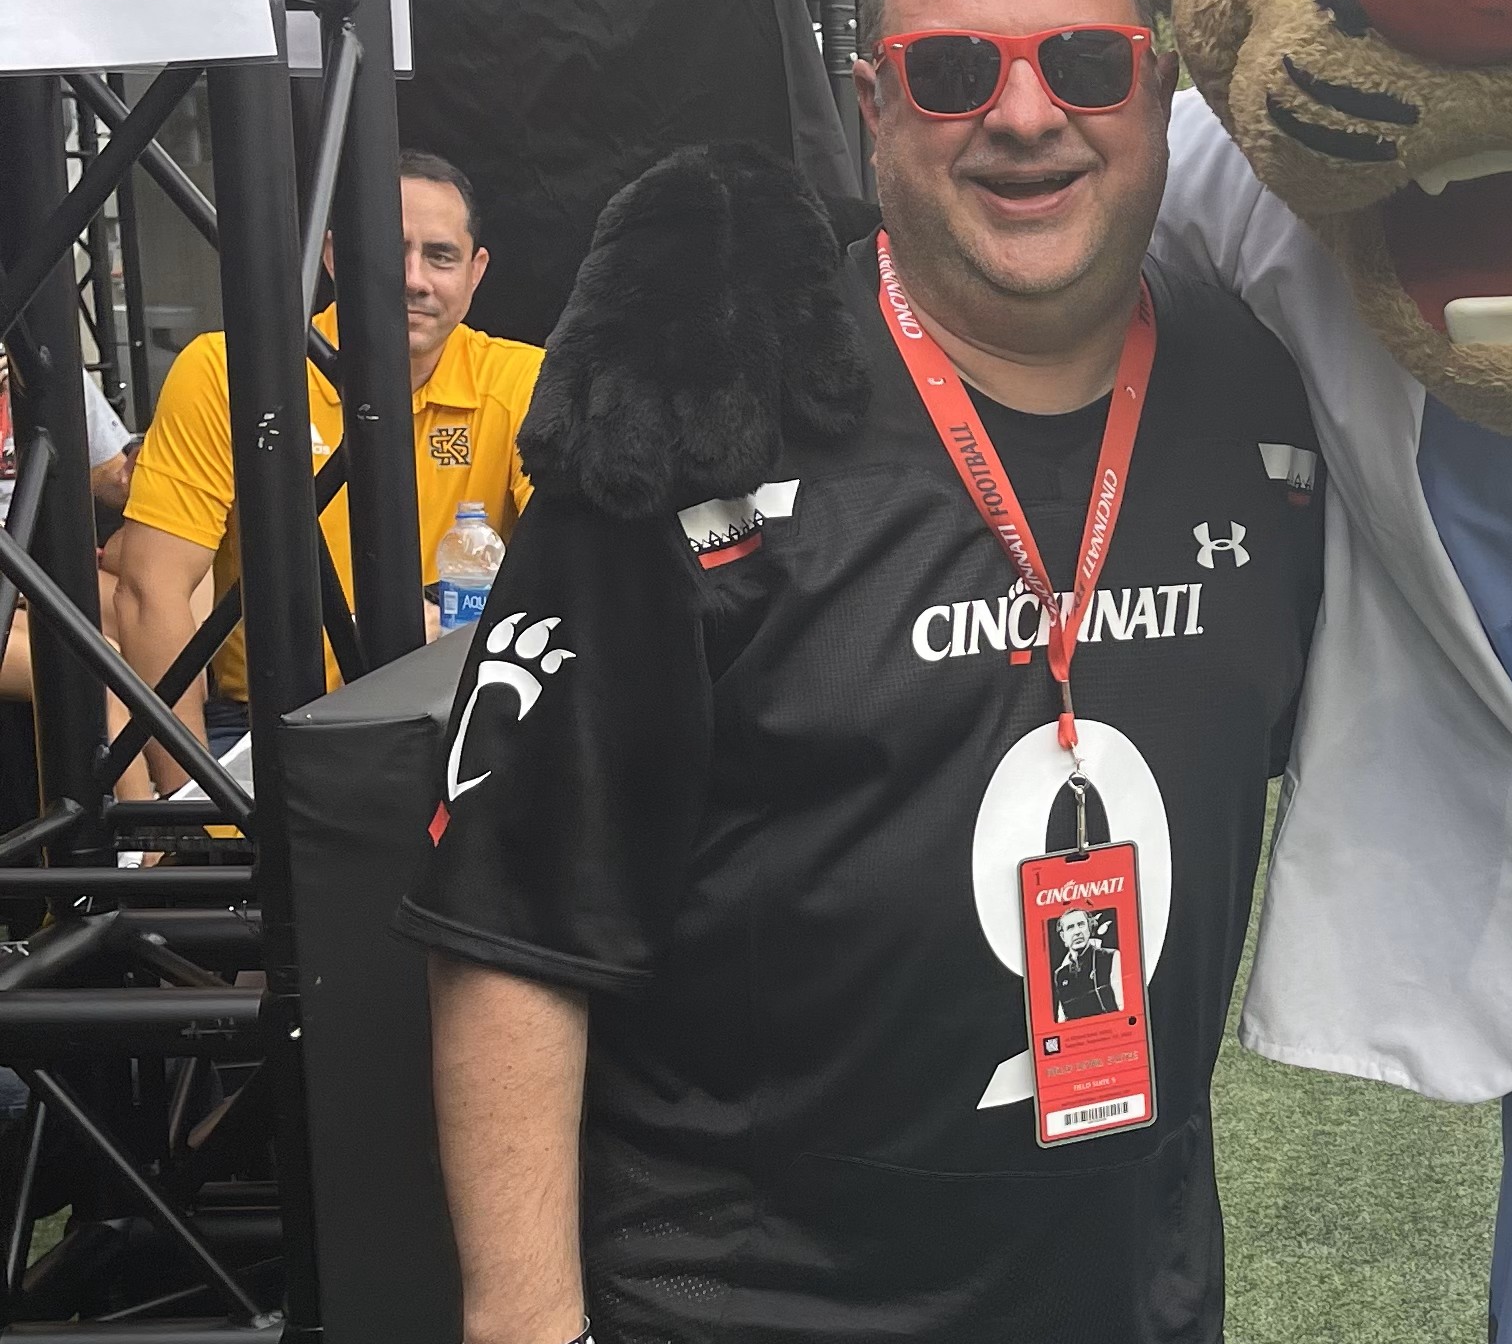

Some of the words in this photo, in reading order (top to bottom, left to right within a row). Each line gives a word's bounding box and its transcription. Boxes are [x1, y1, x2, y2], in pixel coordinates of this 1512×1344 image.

[949, 421, 1010, 518] FOOTBALL
[1082, 467, 1119, 579] CINCINNATI
[1036, 876, 1125, 907] CINCINNATI
